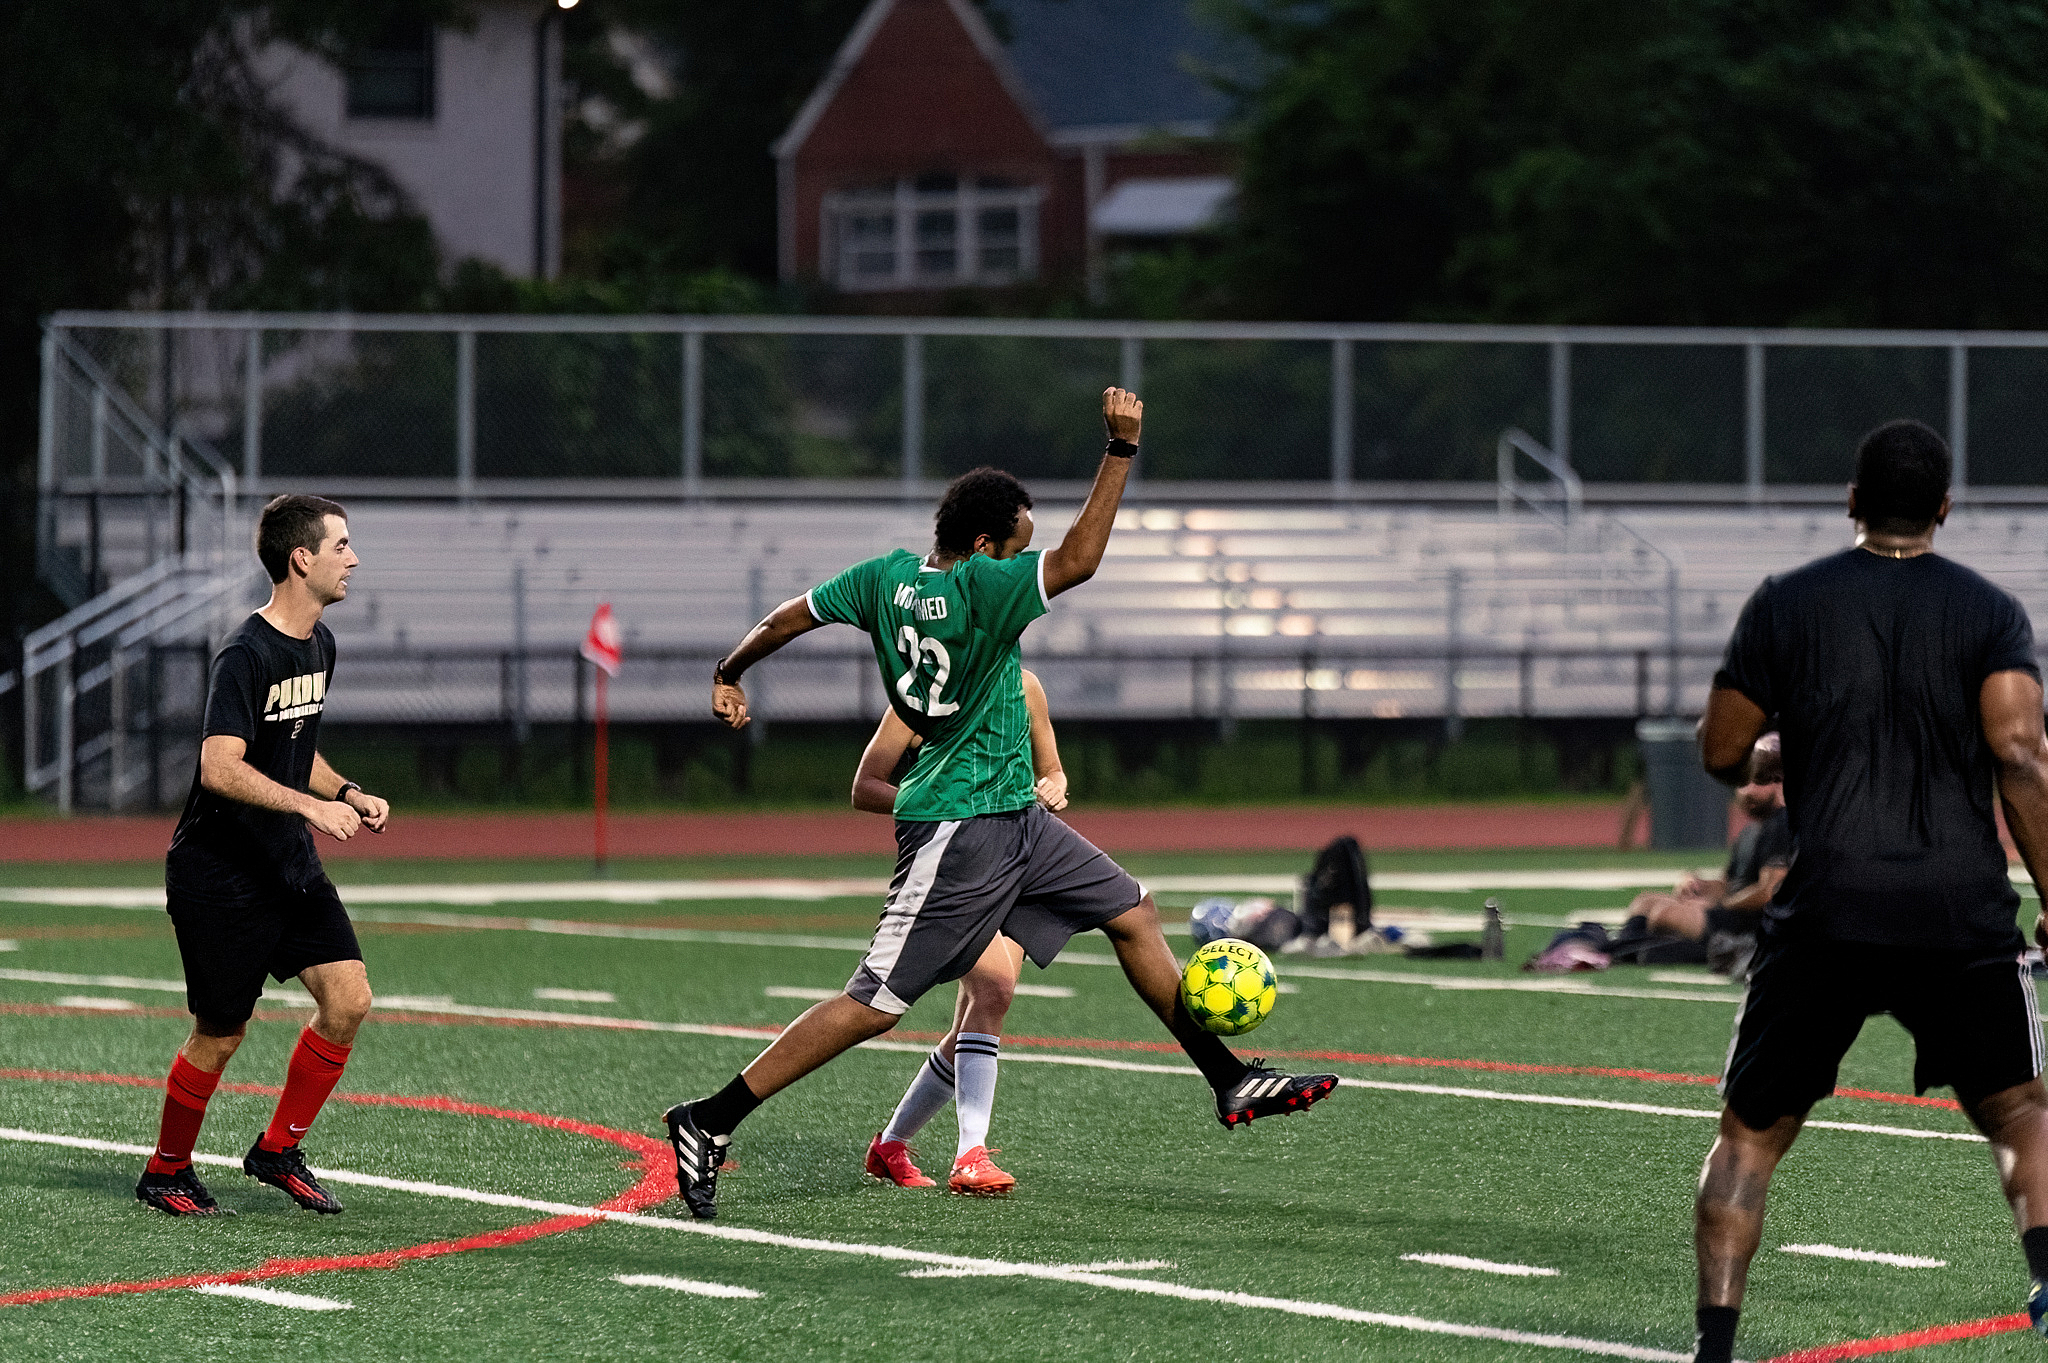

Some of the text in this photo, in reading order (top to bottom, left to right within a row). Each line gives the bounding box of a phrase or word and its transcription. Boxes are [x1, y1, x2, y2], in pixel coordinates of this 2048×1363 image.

[264, 671, 326, 713] PURDU
[896, 625, 960, 717] 22
[1201, 945, 1253, 960] SELECT
